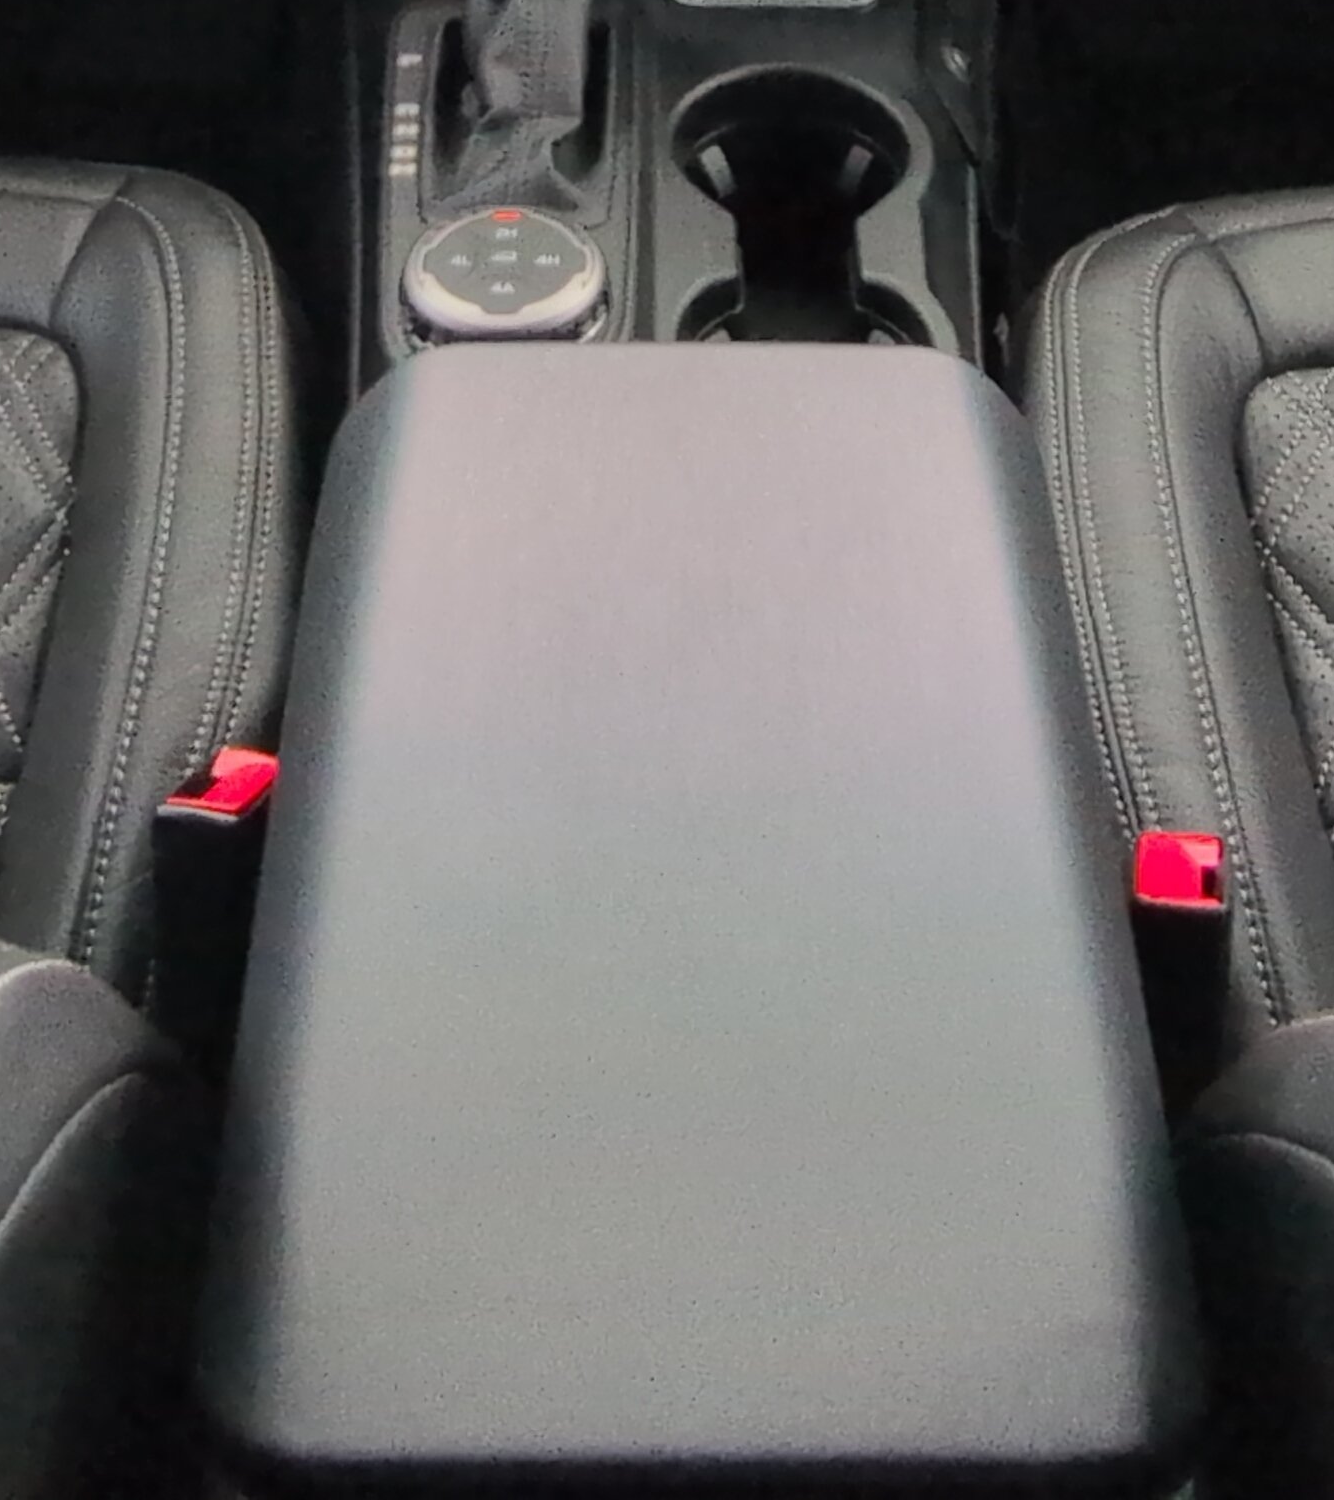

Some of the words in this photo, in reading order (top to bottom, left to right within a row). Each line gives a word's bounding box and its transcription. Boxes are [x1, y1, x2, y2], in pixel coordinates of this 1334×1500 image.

[450, 254, 472, 267] 4L
[534, 253, 560, 266] 4H
[490, 281, 516, 294] 4A
